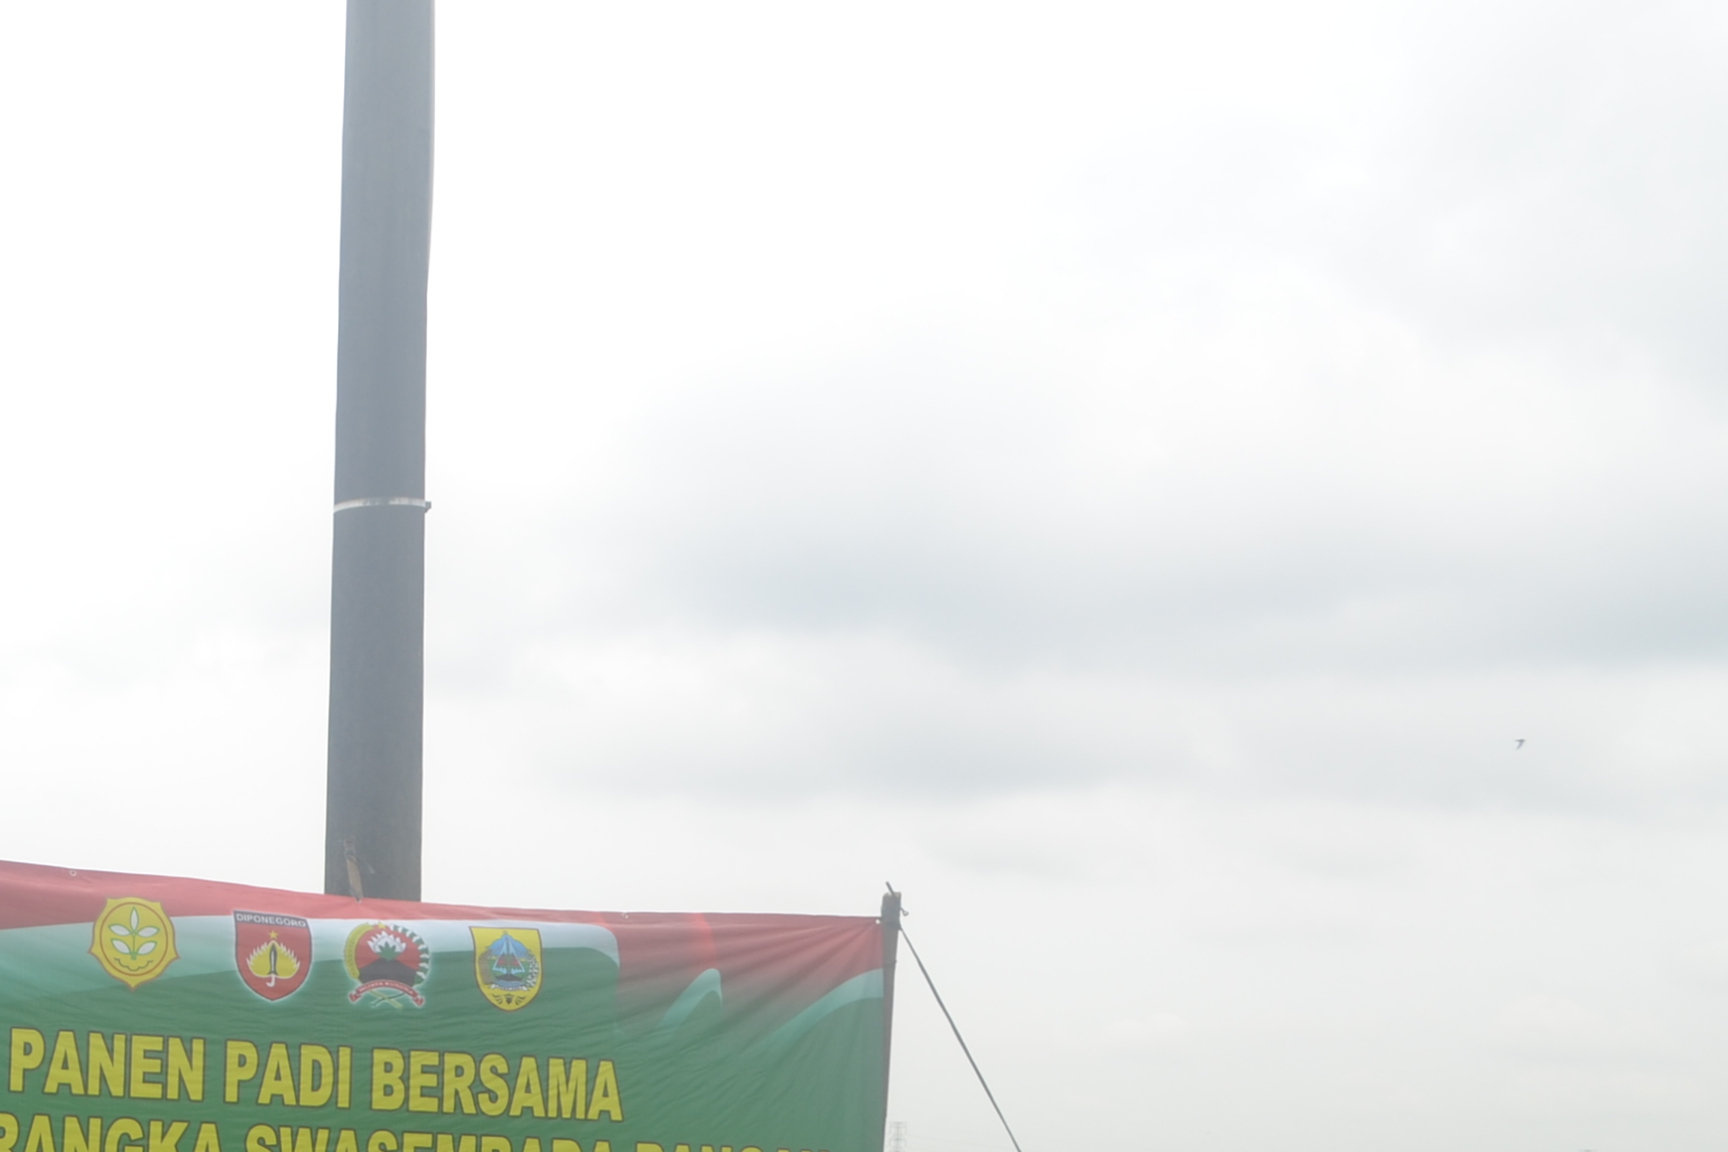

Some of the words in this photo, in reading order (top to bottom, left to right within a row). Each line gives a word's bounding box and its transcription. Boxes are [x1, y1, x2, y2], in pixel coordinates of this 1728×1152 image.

[235, 912, 307, 928] DIPONEGORO
[8, 1026, 206, 1102] PANEN
[223, 1038, 353, 1110] PADI
[370, 1047, 624, 1123] BERSAMA
